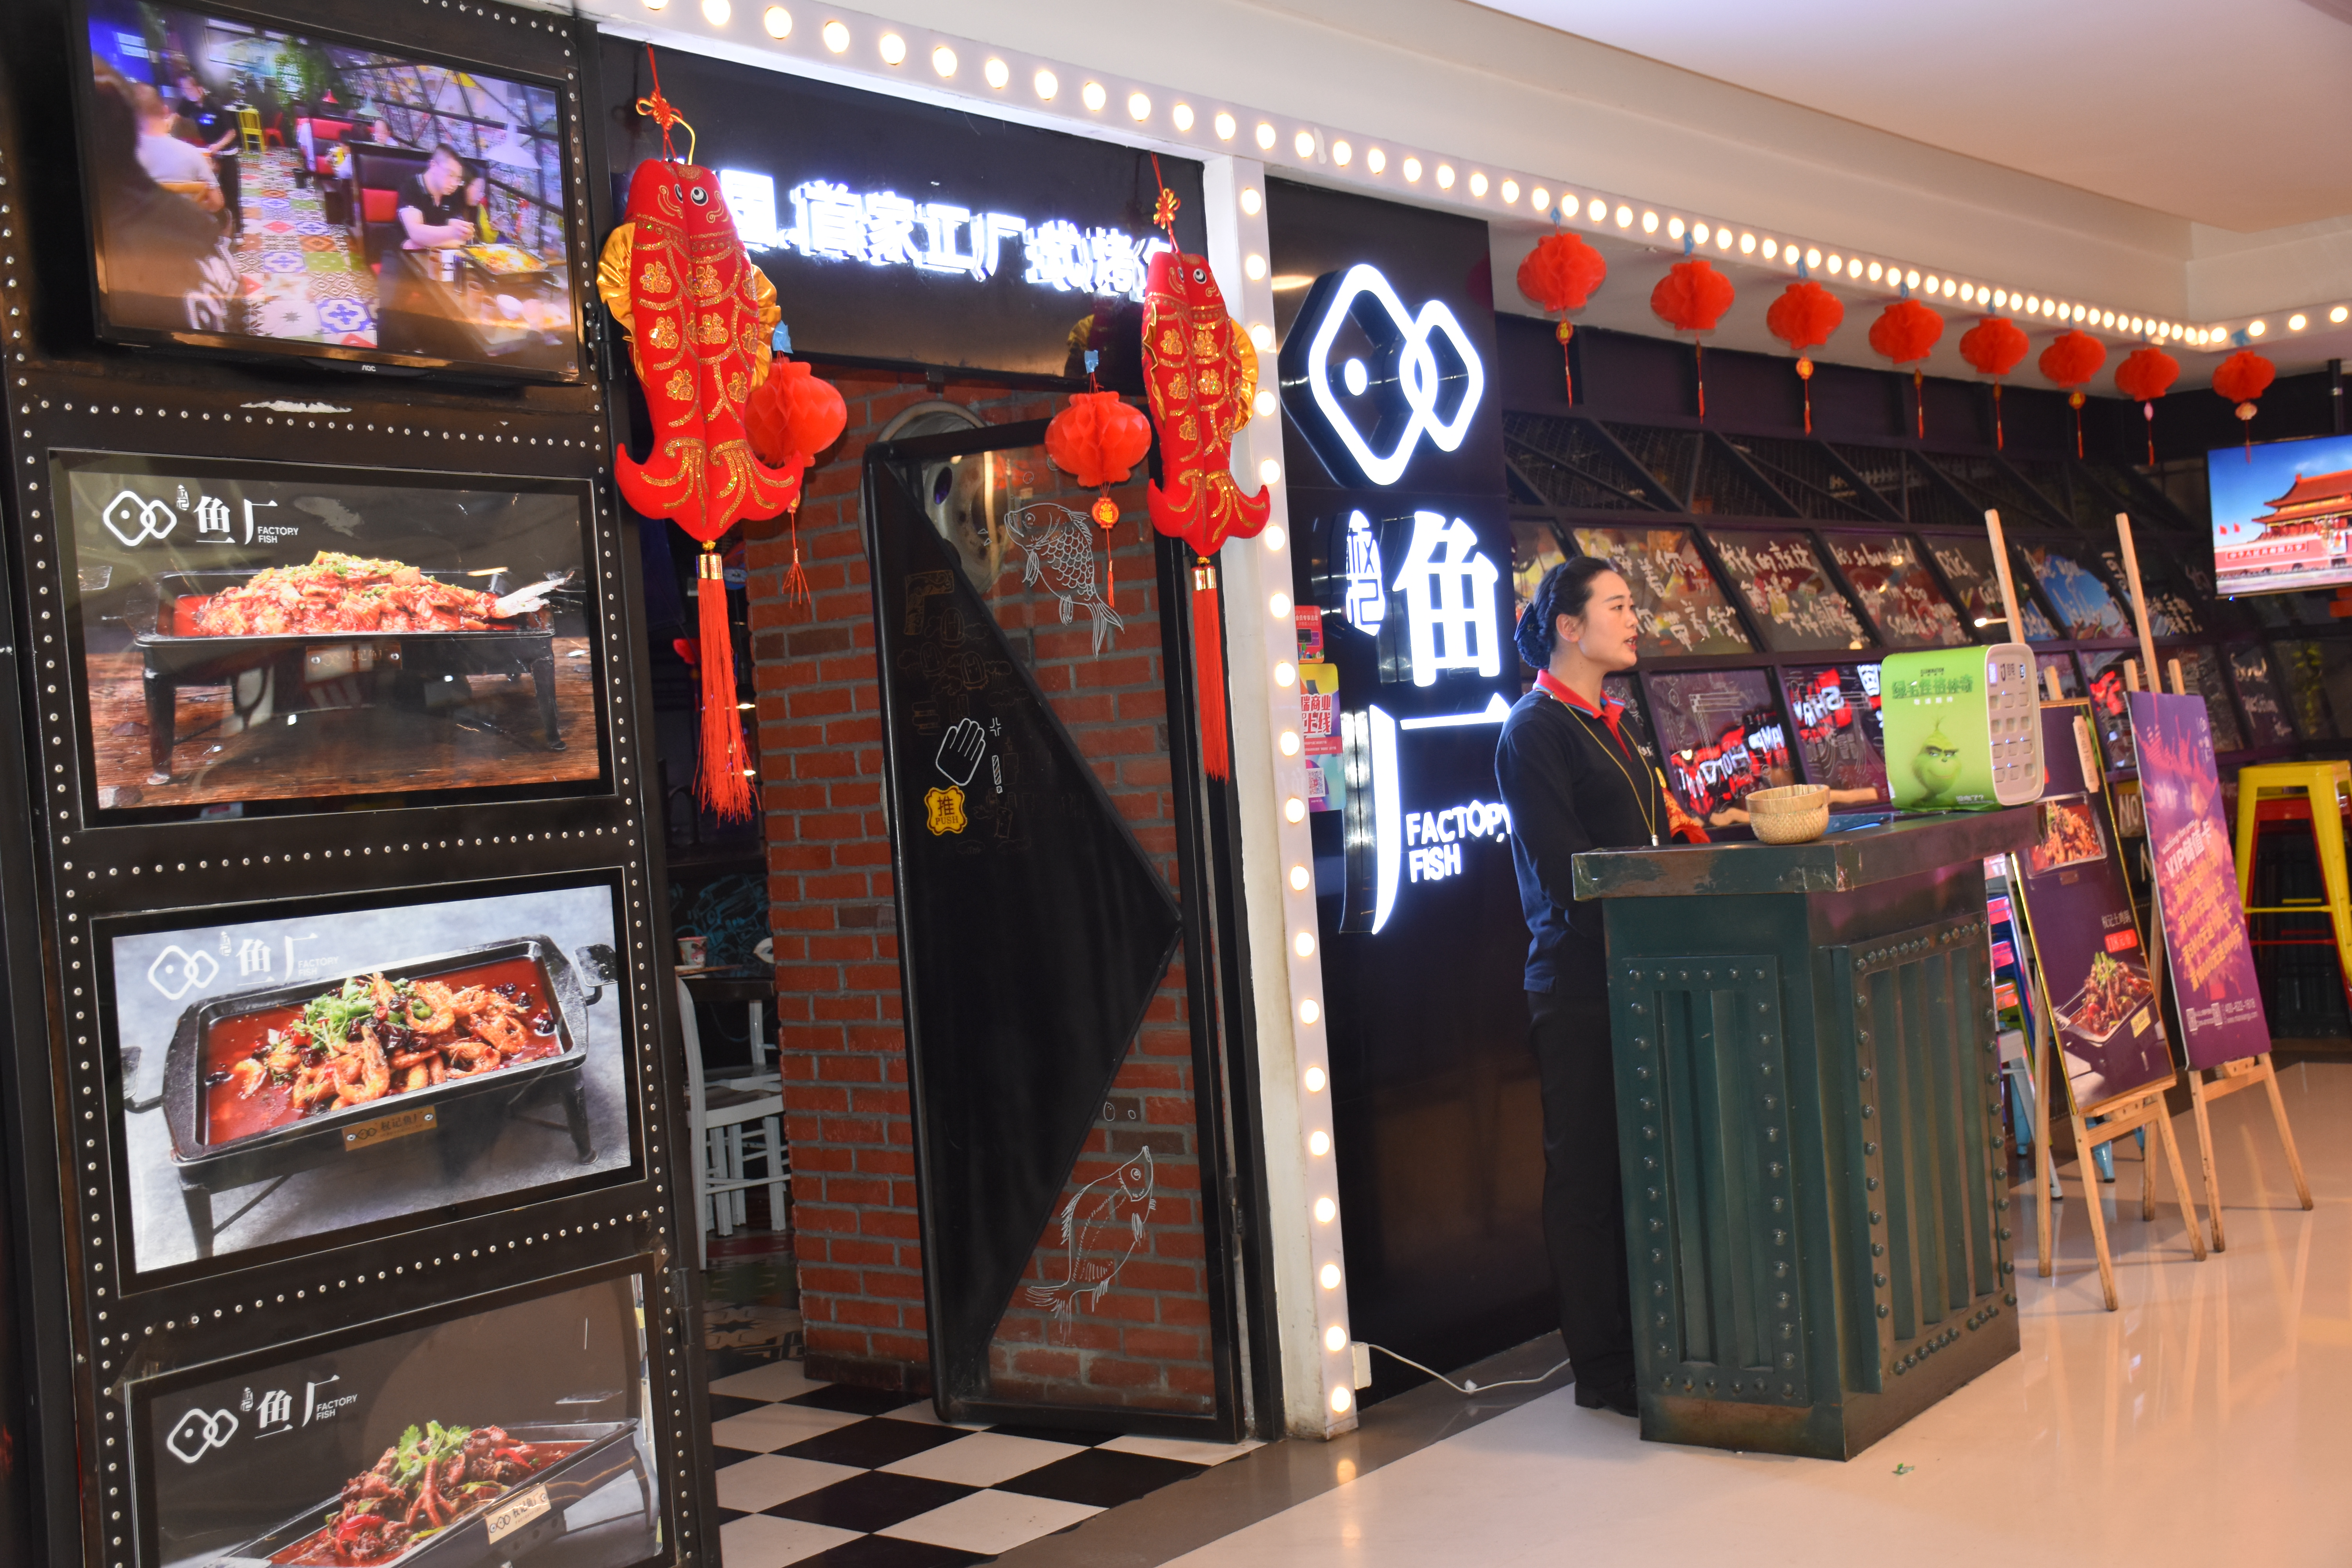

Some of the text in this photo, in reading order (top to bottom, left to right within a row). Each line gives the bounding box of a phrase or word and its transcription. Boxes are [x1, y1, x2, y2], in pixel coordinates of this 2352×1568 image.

[258, 526, 299, 536] FACTORY
[258, 535, 278, 544] FISH
[937, 795, 955, 816] 推
[935, 816, 958, 825] PUSH
[1408, 844, 1462, 883] FISH
[298, 956, 339, 969] FACTORY
[298, 966, 318, 977] FISH
[316, 1394, 358, 1412] FACTORY
[316, 1408, 336, 1421] FISH
